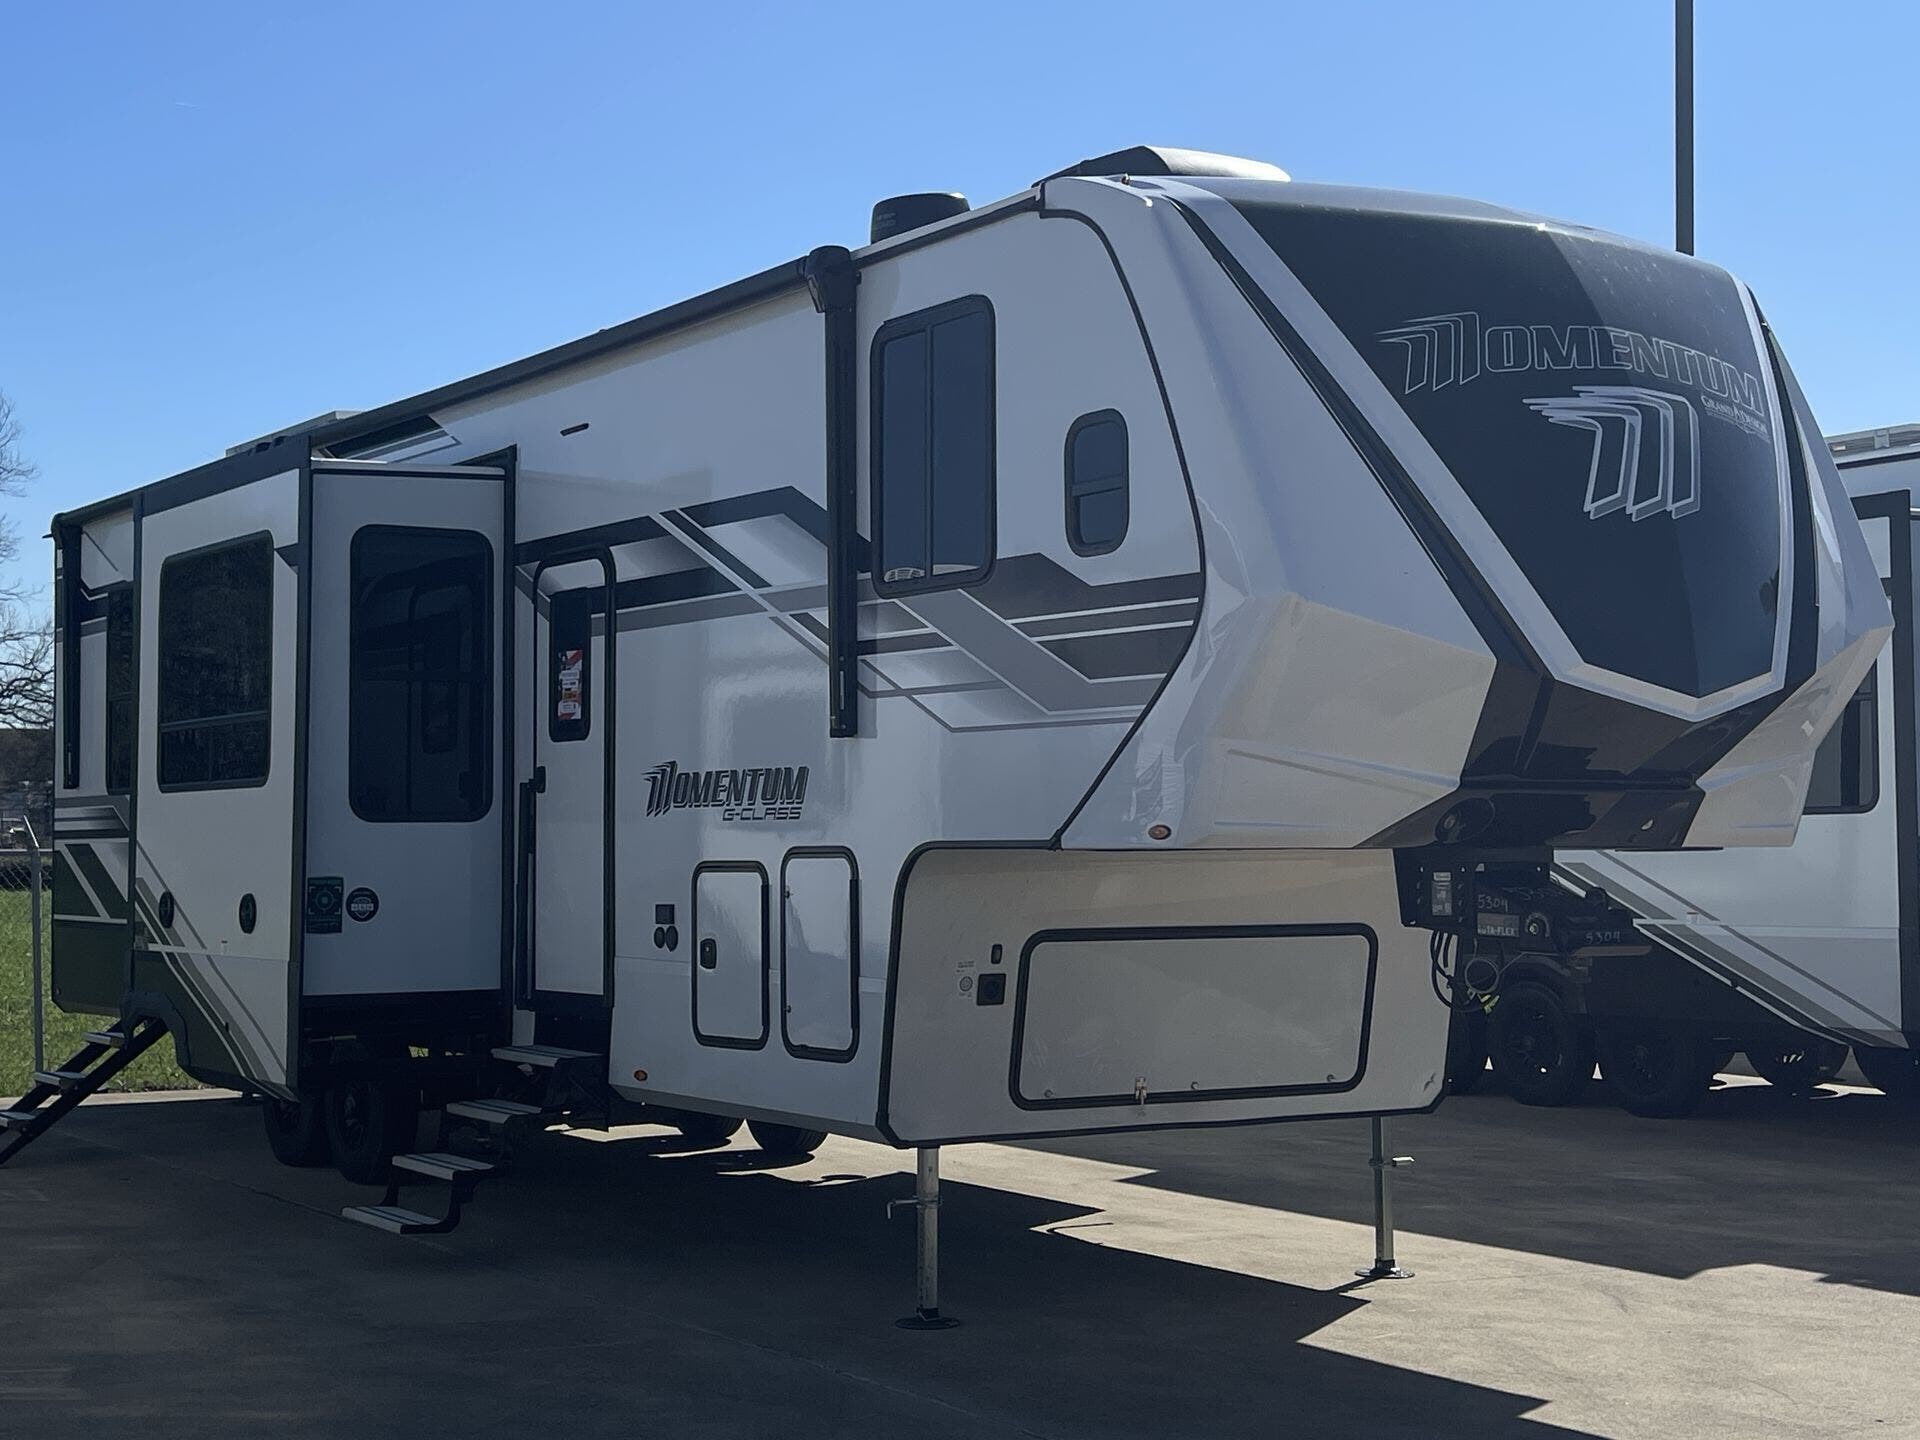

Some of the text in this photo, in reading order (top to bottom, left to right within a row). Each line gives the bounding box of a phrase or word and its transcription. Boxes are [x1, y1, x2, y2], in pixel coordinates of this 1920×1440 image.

[1375, 311, 1765, 416] MOMENTUM
[641, 760, 810, 817] MOMENTUM
[722, 807, 803, 822] G-CLASS
[1477, 894, 1509, 912] 5304
[1585, 931, 1621, 945] 5304
